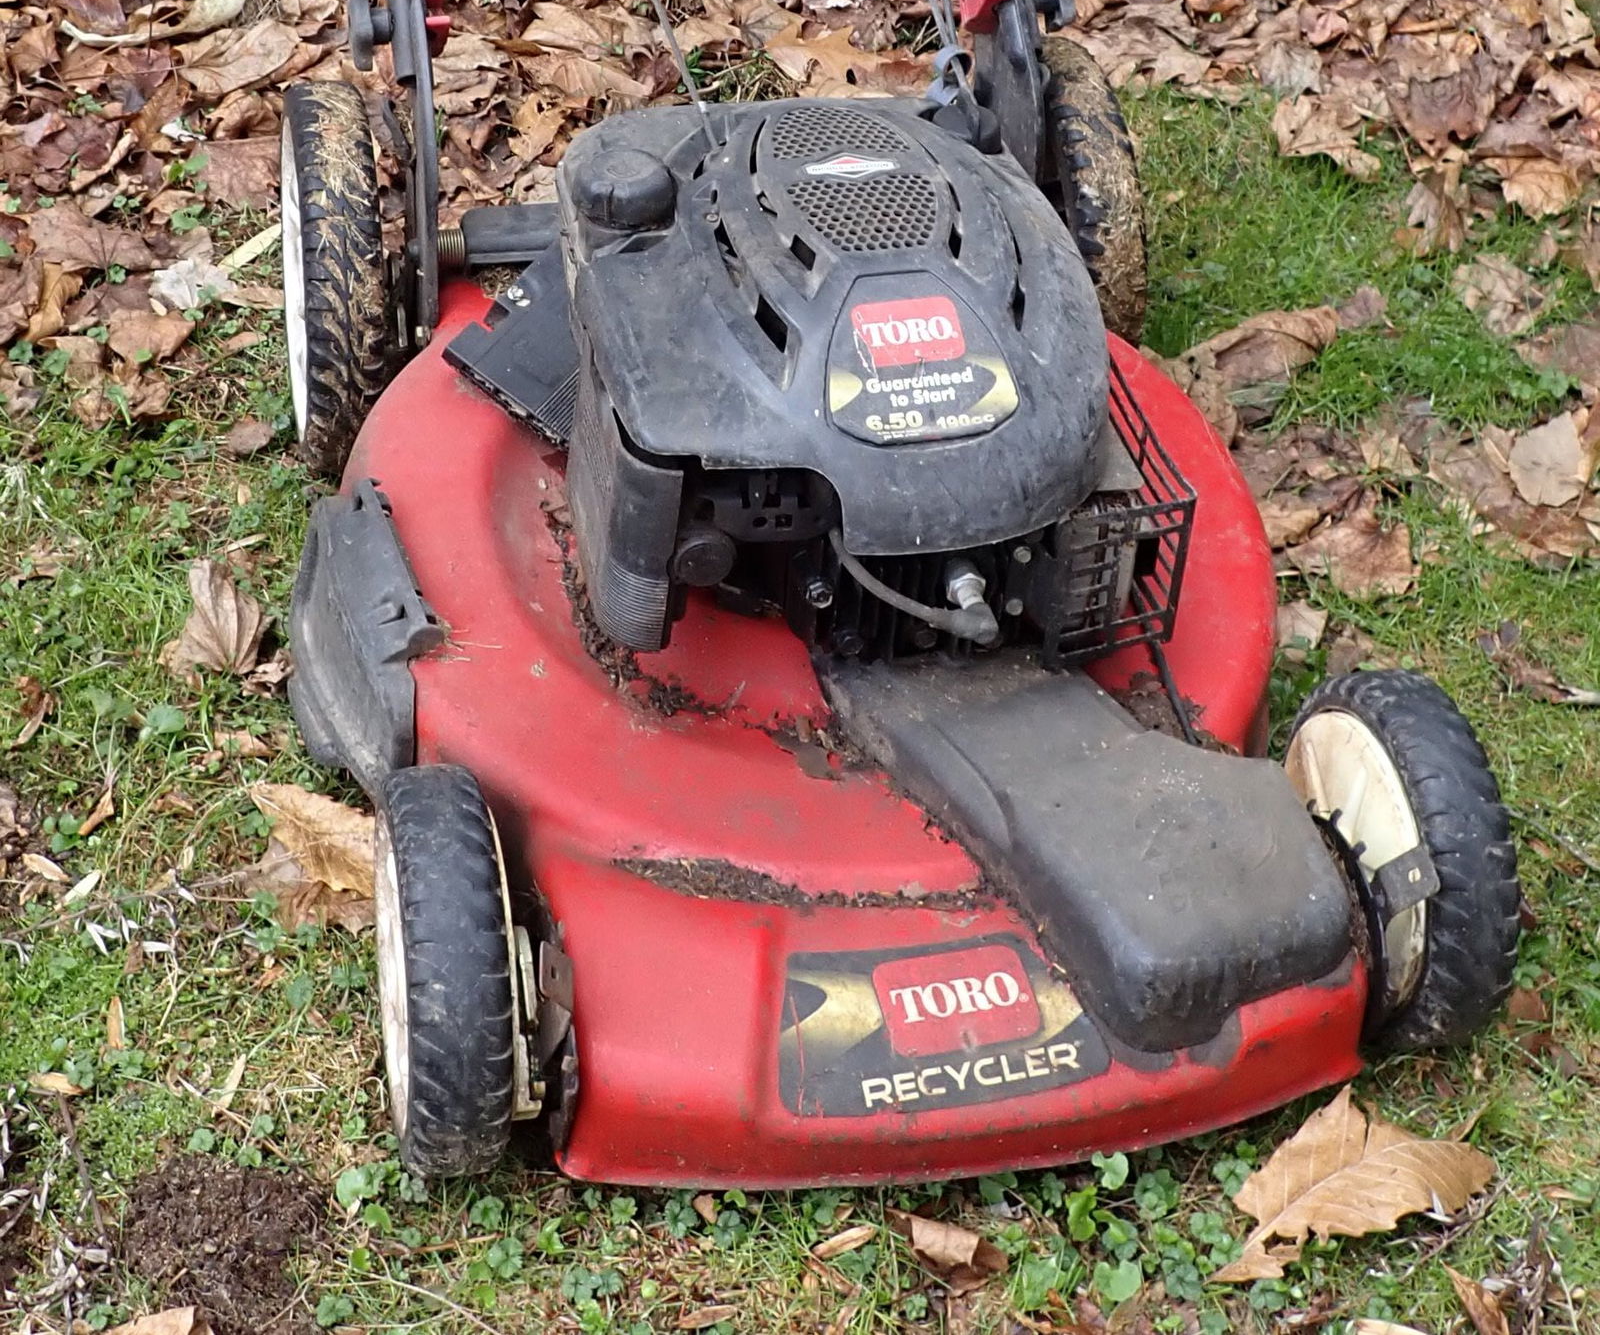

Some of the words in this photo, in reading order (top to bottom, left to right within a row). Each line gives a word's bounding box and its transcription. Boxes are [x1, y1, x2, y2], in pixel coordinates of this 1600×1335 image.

[862, 316, 953, 348] TORO
[866, 366, 974, 394] Guaranteed
[890, 393, 910, 408] to
[913, 387, 956, 406] Start
[866, 410, 924, 431] 6.50
[890, 971, 1020, 1024] TORO
[862, 1043, 1081, 1108] RECYCLER
